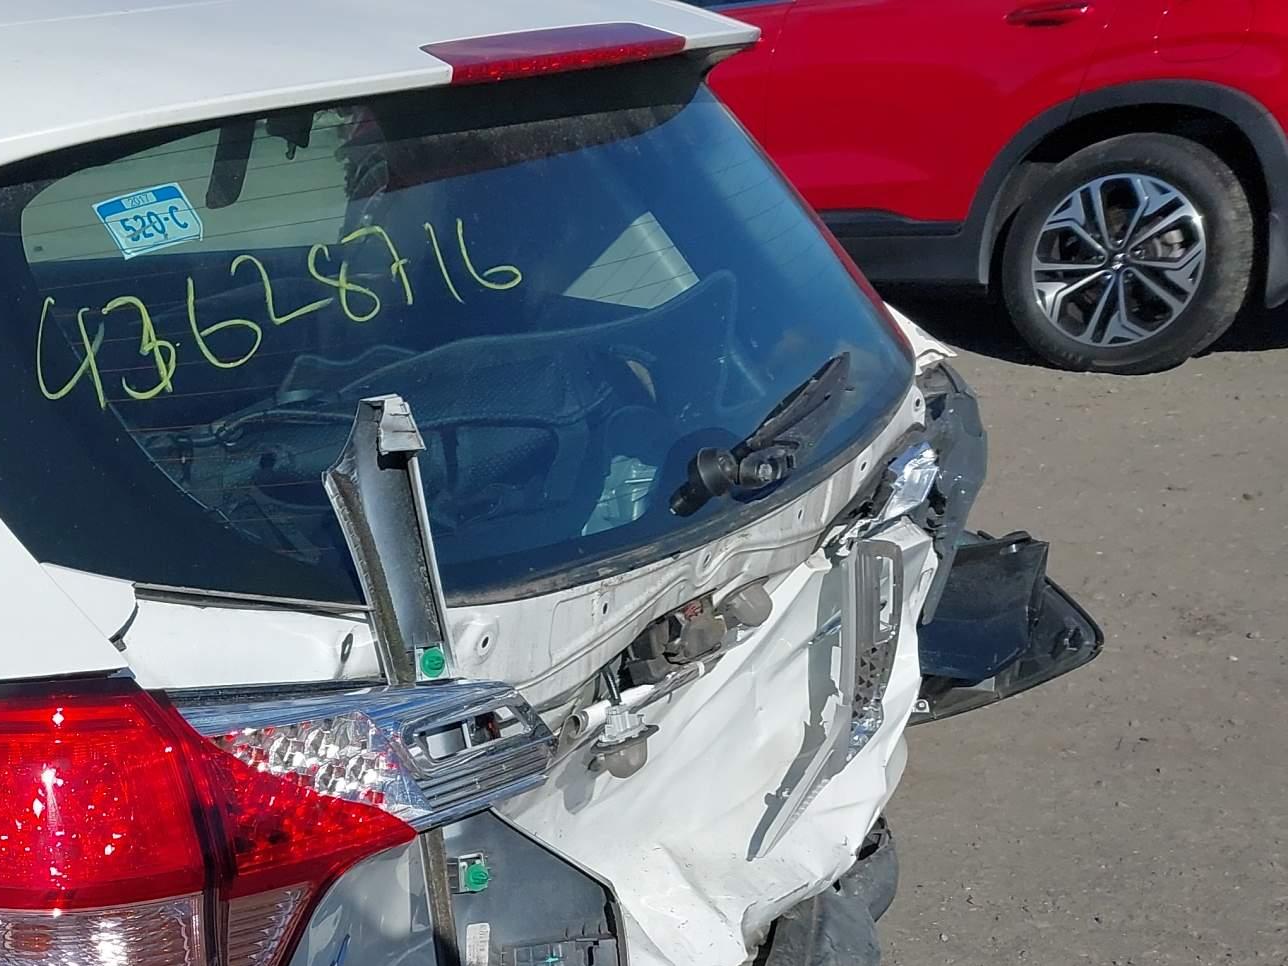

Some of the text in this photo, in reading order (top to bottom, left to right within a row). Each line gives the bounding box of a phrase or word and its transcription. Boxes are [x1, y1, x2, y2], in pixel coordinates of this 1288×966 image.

[127, 193, 149, 207] 2017
[119, 205, 189, 241] 520-C
[37, 218, 522, 409] 43628716
